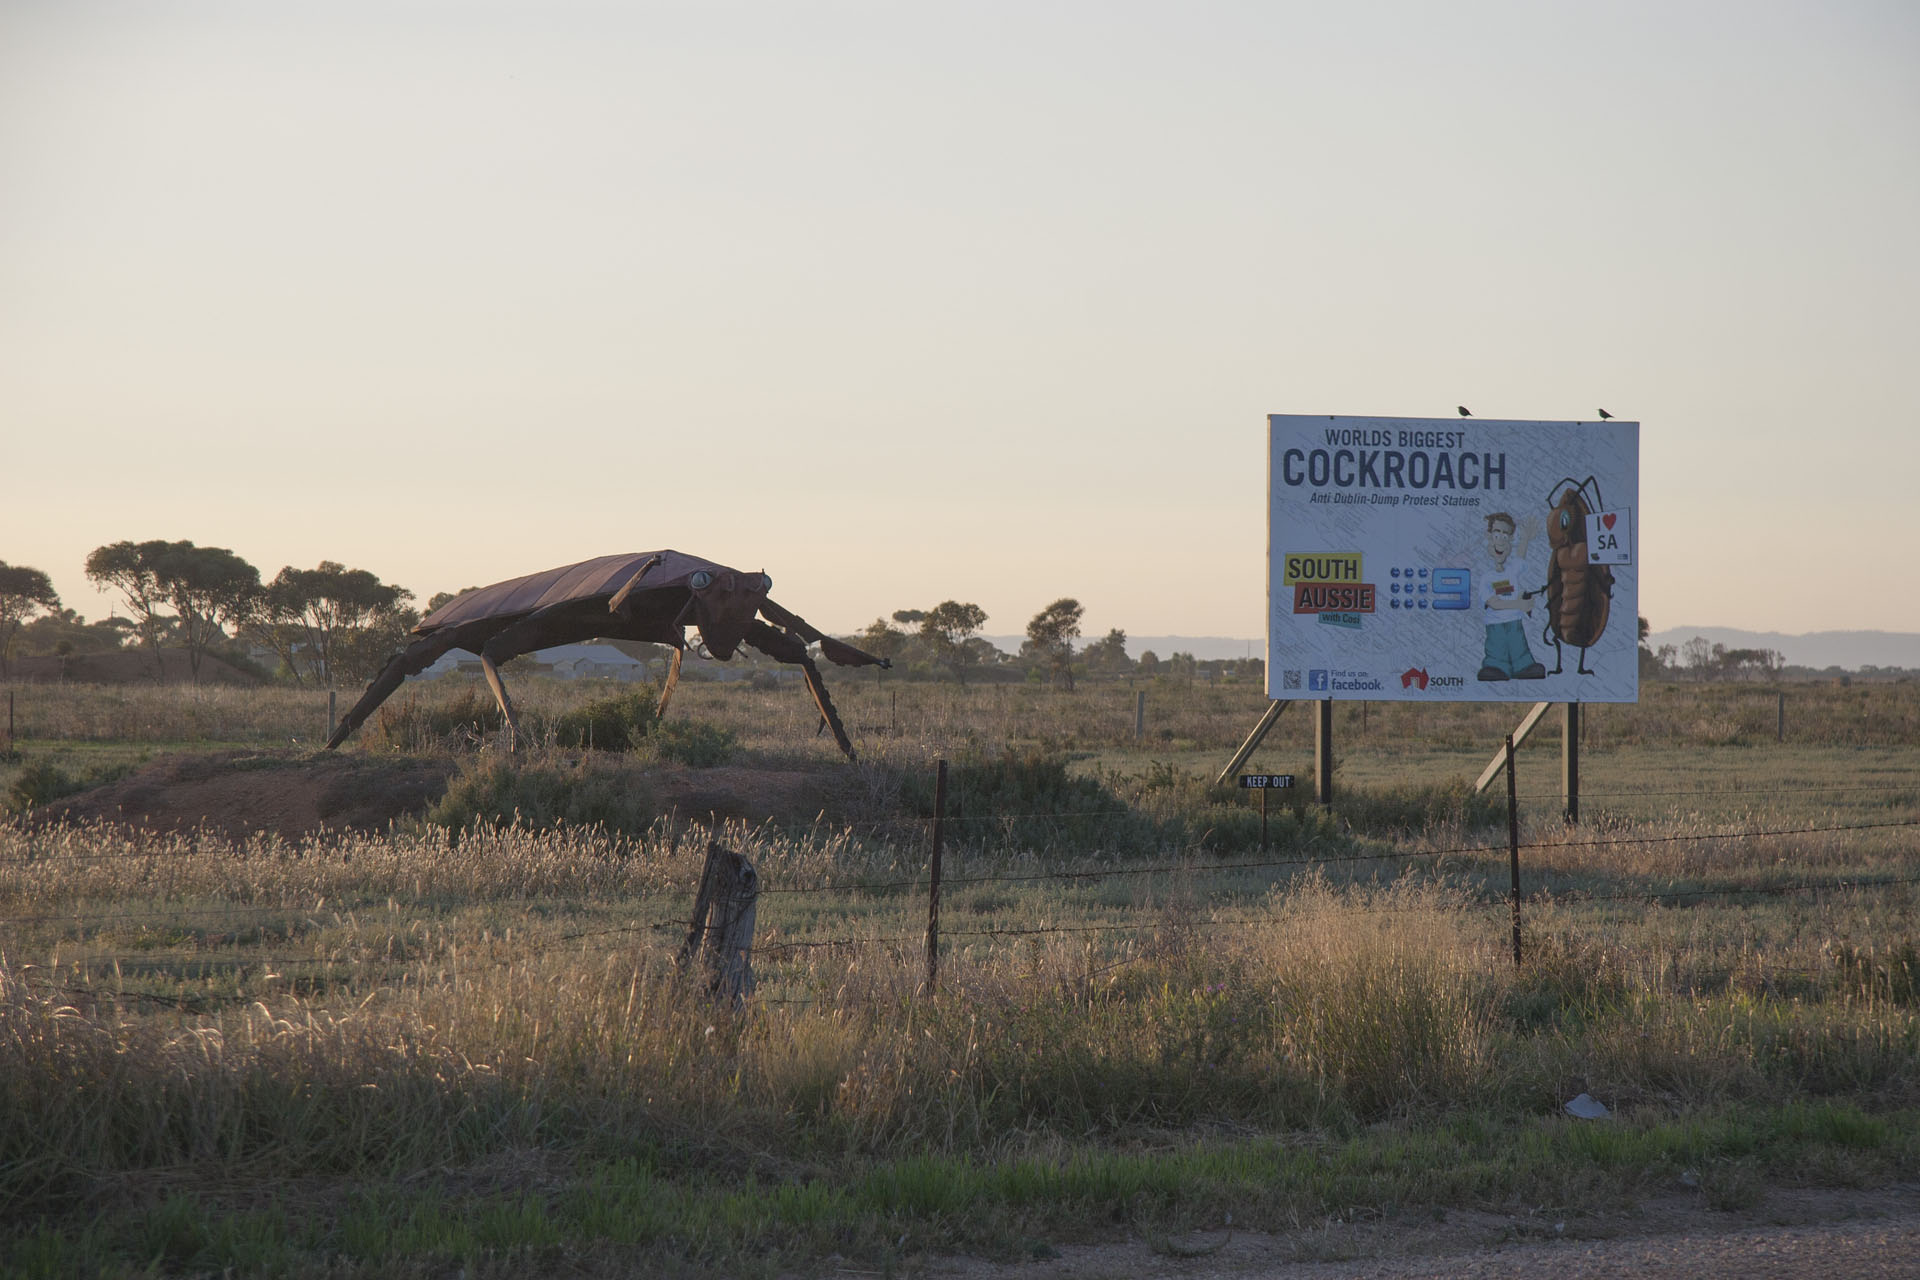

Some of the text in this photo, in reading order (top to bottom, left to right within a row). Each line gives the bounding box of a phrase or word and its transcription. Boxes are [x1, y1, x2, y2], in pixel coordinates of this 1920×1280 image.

[1325, 429, 1465, 448] WORLDS BIGGEST
[1283, 449, 1506, 490] COCKROACH
[1309, 492, 1481, 508] Anti Dublin-Dump Protest Statues
[1597, 515, 1600, 531] I
[1598, 534, 1618, 550] SA
[1288, 558, 1358, 580] SOUTH
[1299, 587, 1373, 609] AUSSIE
[1342, 613, 1361, 625] Cosi
[1430, 677, 1464, 687] SOUTH
[1247, 776, 1289, 787] KEEP OUT
